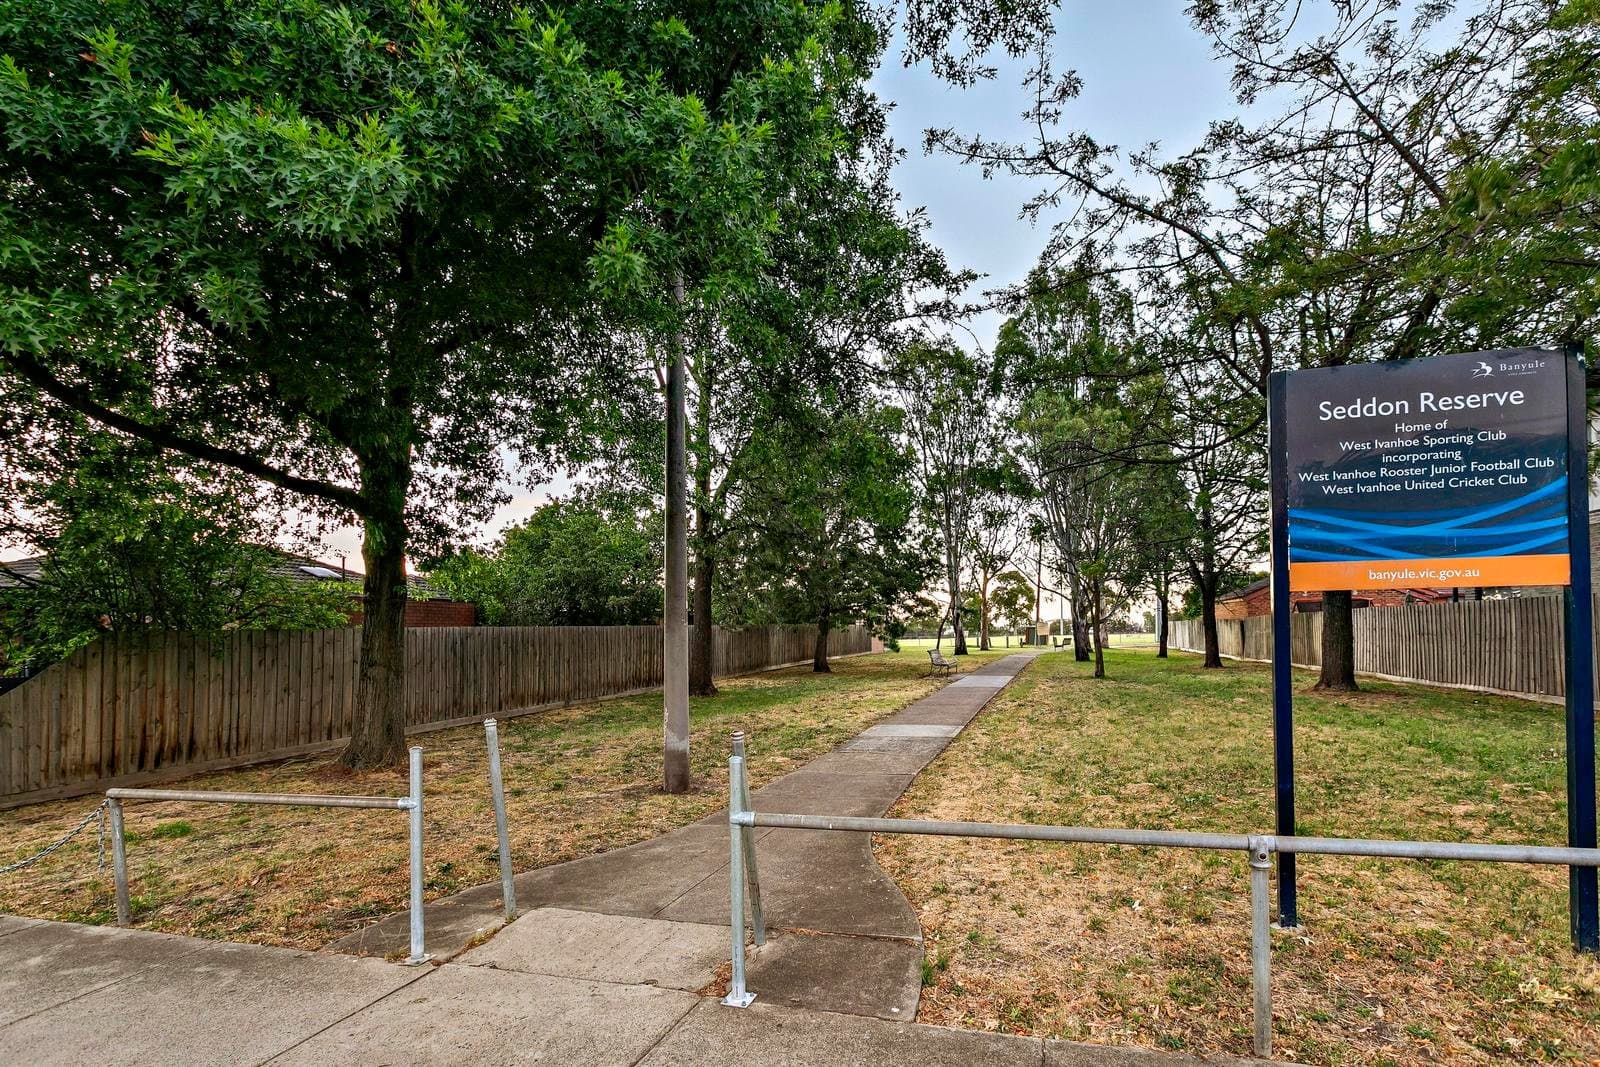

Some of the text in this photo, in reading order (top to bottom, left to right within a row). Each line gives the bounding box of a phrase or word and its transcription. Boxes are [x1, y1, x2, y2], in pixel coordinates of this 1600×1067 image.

[1499, 361, 1545, 371] Banyule
[1319, 389, 1525, 421] Seddon Reserve
[1395, 420, 1448, 433] Home of
[1339, 430, 1507, 451] West Ivanhoe Sporting Club
[1382, 450, 1462, 463] incorporating
[1298, 457, 1555, 482] West Ivanhoe Rooster Junior Football Club
[1322, 474, 1528, 495] West Ivanhoe United Cricket Club
[1368, 567, 1480, 581] banyule.vic.gov.au
